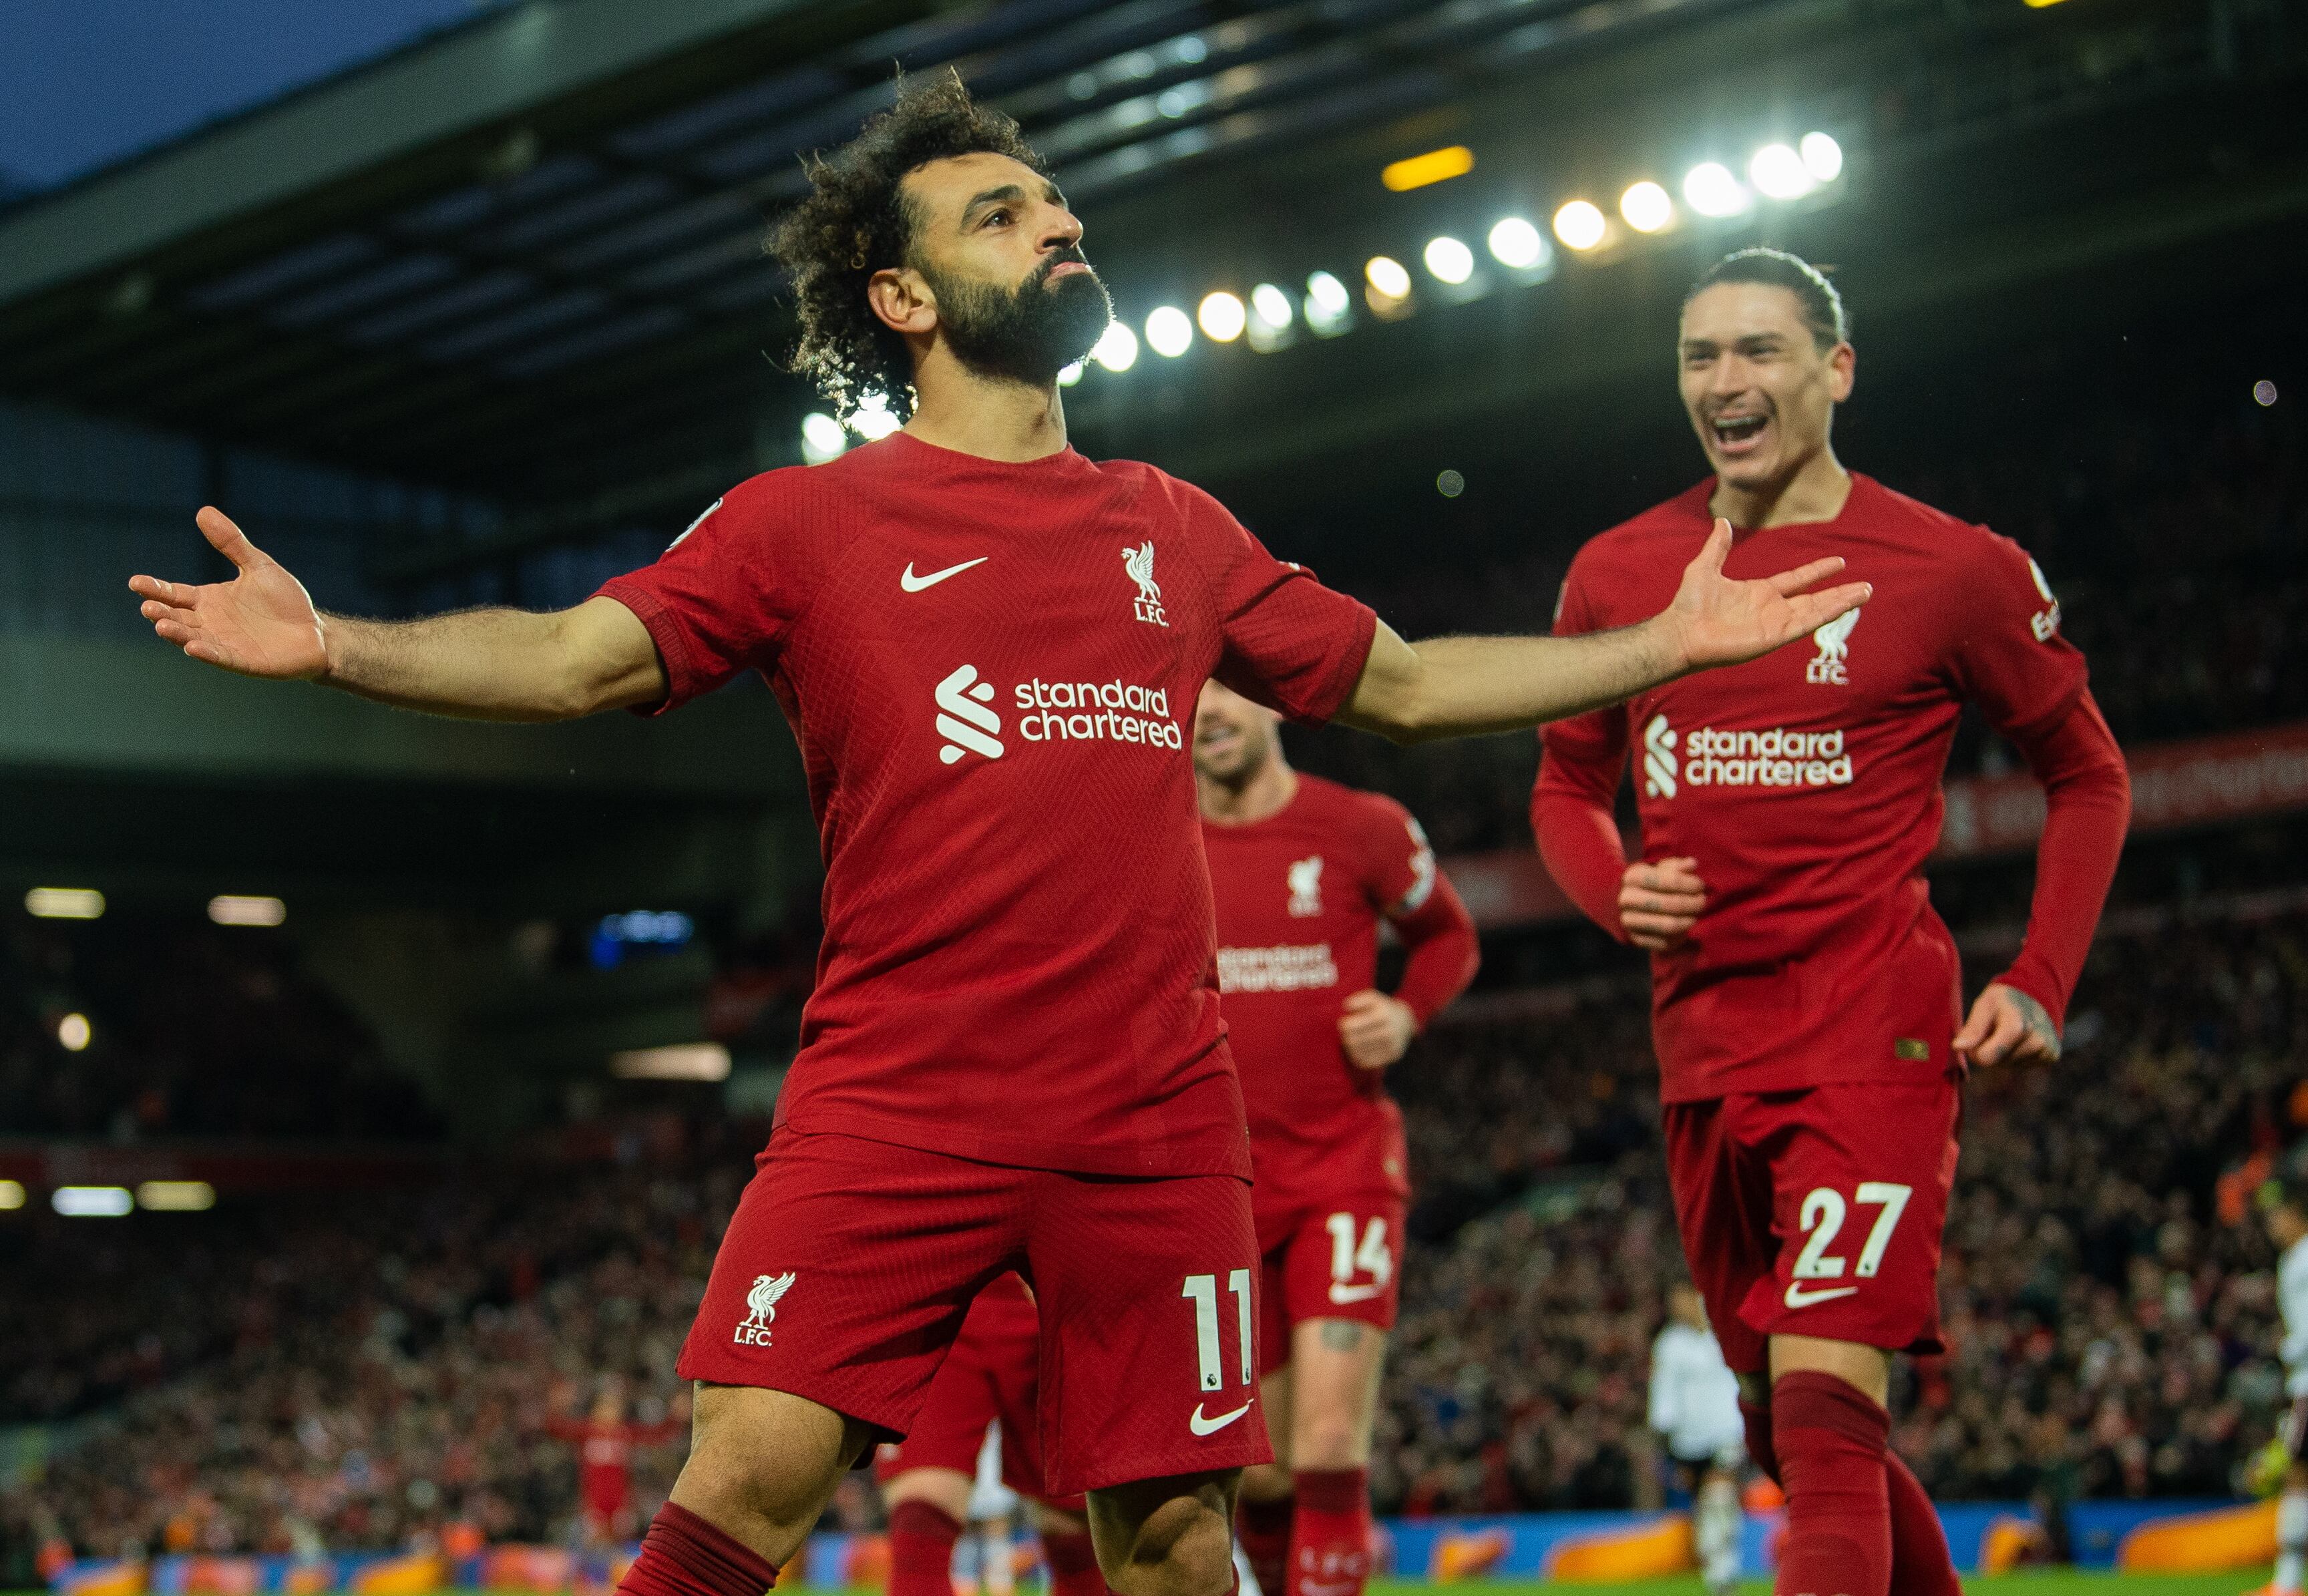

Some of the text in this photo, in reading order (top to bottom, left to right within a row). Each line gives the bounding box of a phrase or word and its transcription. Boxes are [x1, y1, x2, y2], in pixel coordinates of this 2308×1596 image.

[1134, 602, 1169, 628] L.F.C.
[1014, 677, 1169, 718] standard
[1020, 708, 1182, 750] chartered
[1686, 726, 1844, 759] standard
[1685, 753, 1853, 793] chartered
[1326, 1211, 1392, 1286] 14
[1792, 1181, 1913, 1279] 27
[733, 1326, 773, 1347] L.F.C.
[1181, 1268, 1252, 1392] 11
